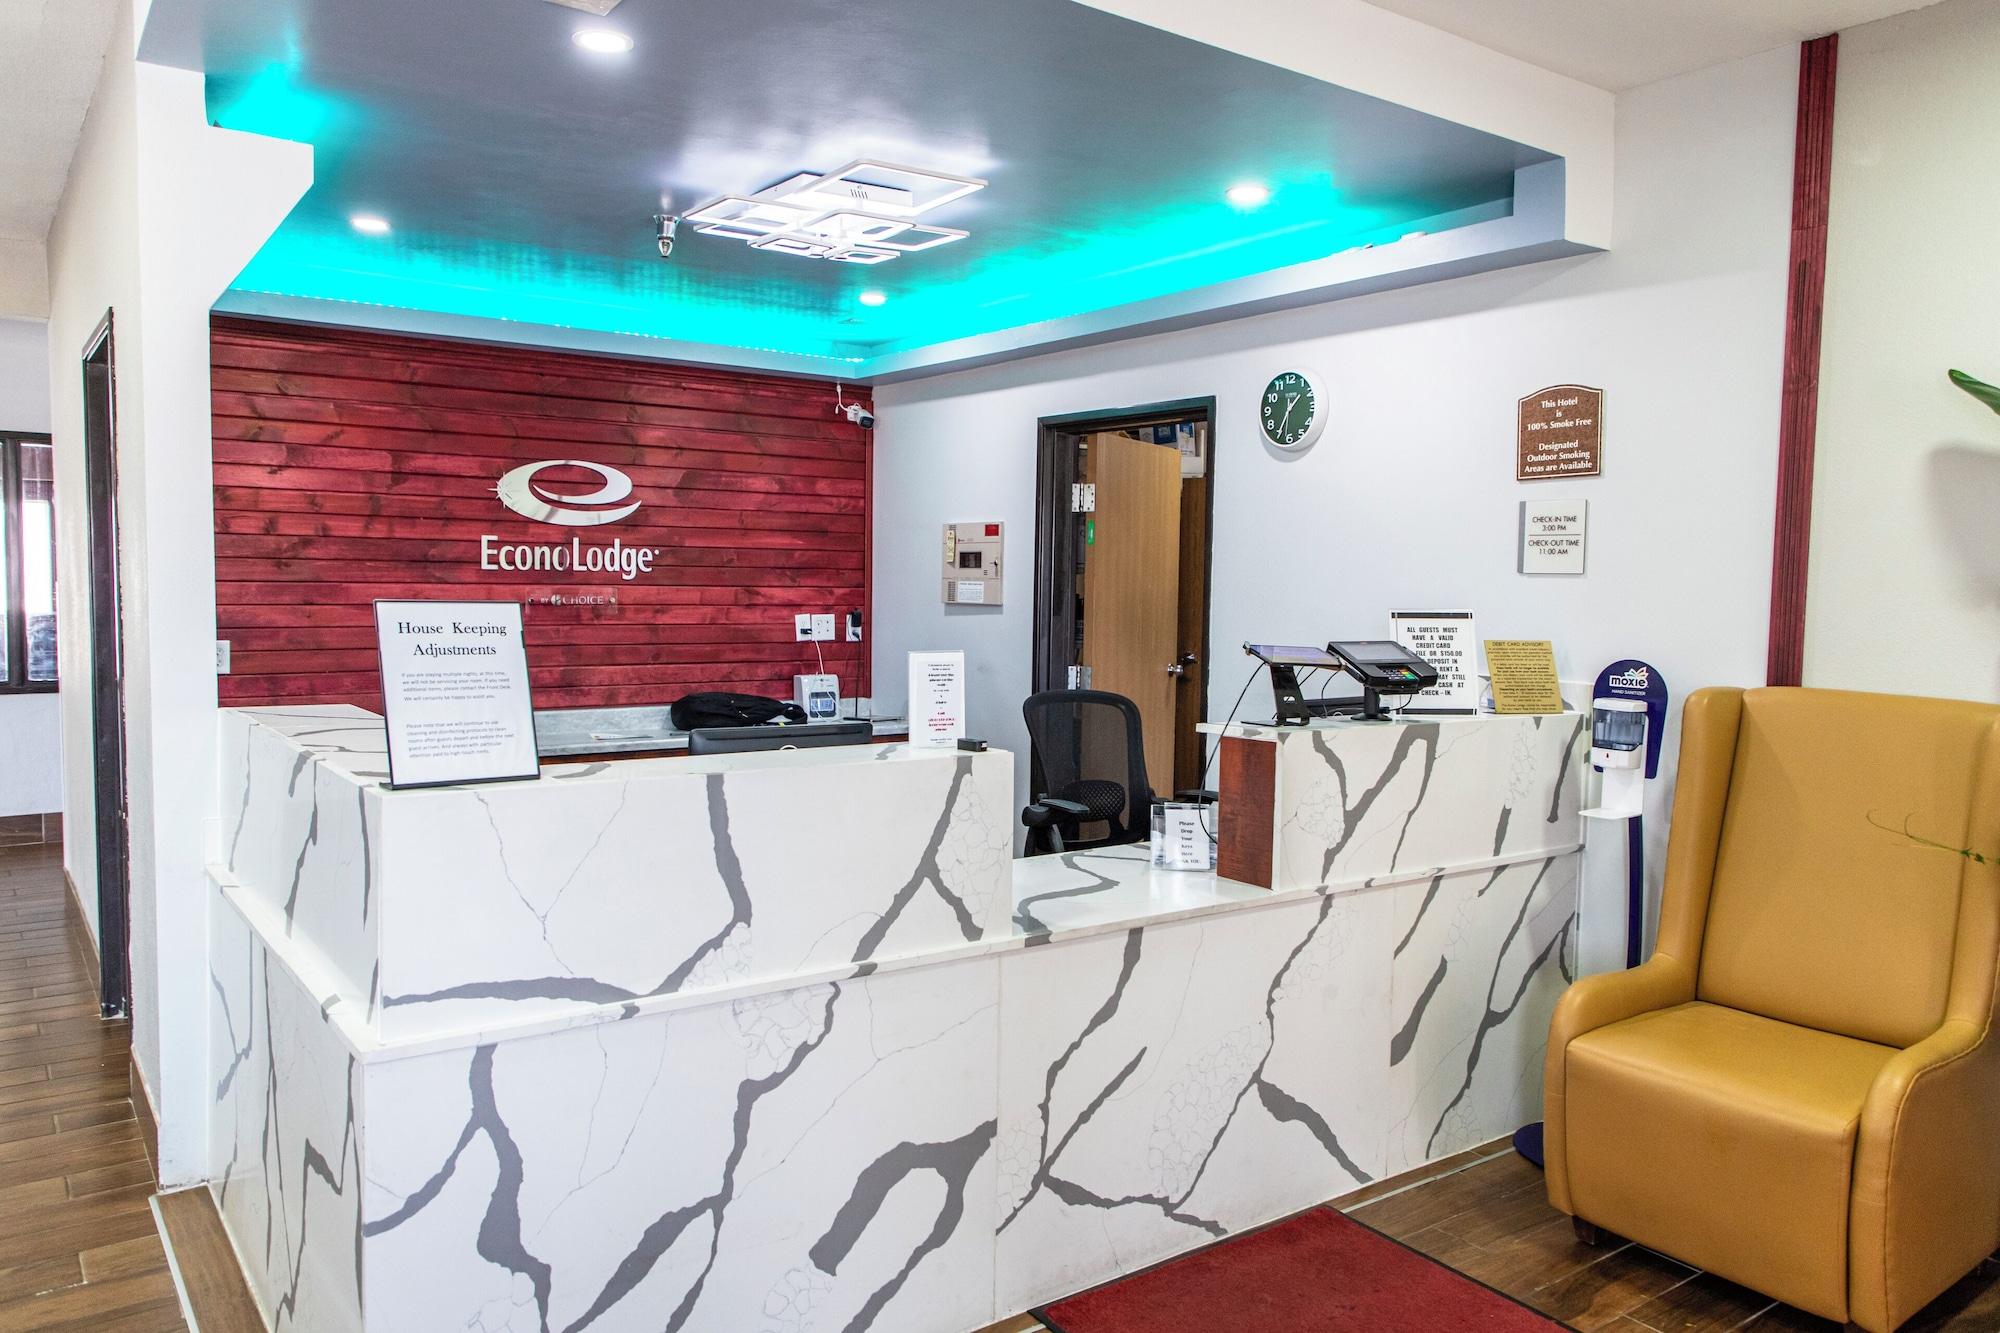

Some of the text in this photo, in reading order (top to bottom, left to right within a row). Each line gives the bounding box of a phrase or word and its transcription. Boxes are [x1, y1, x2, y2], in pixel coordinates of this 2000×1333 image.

[1285, 375, 1296, 384] 12
[1300, 378, 1304, 387] 1
[1275, 380, 1283, 390] 11
[1267, 393, 1278, 403] 10
[1558, 397, 1578, 406] Hotel
[1264, 407, 1271, 416] 9
[1267, 420, 1274, 430] 8
[1550, 420, 1574, 428] Smoke
[1286, 434, 1293, 443] 6
[1539, 440, 1578, 451] Designated
[1527, 450, 1590, 462] Outdoor Smoking
[1559, 461, 1592, 470] Available
[398, 622, 506, 636] House Keeping
[413, 644, 496, 658] Adjustments
[1610, 676, 1647, 688] moxie
